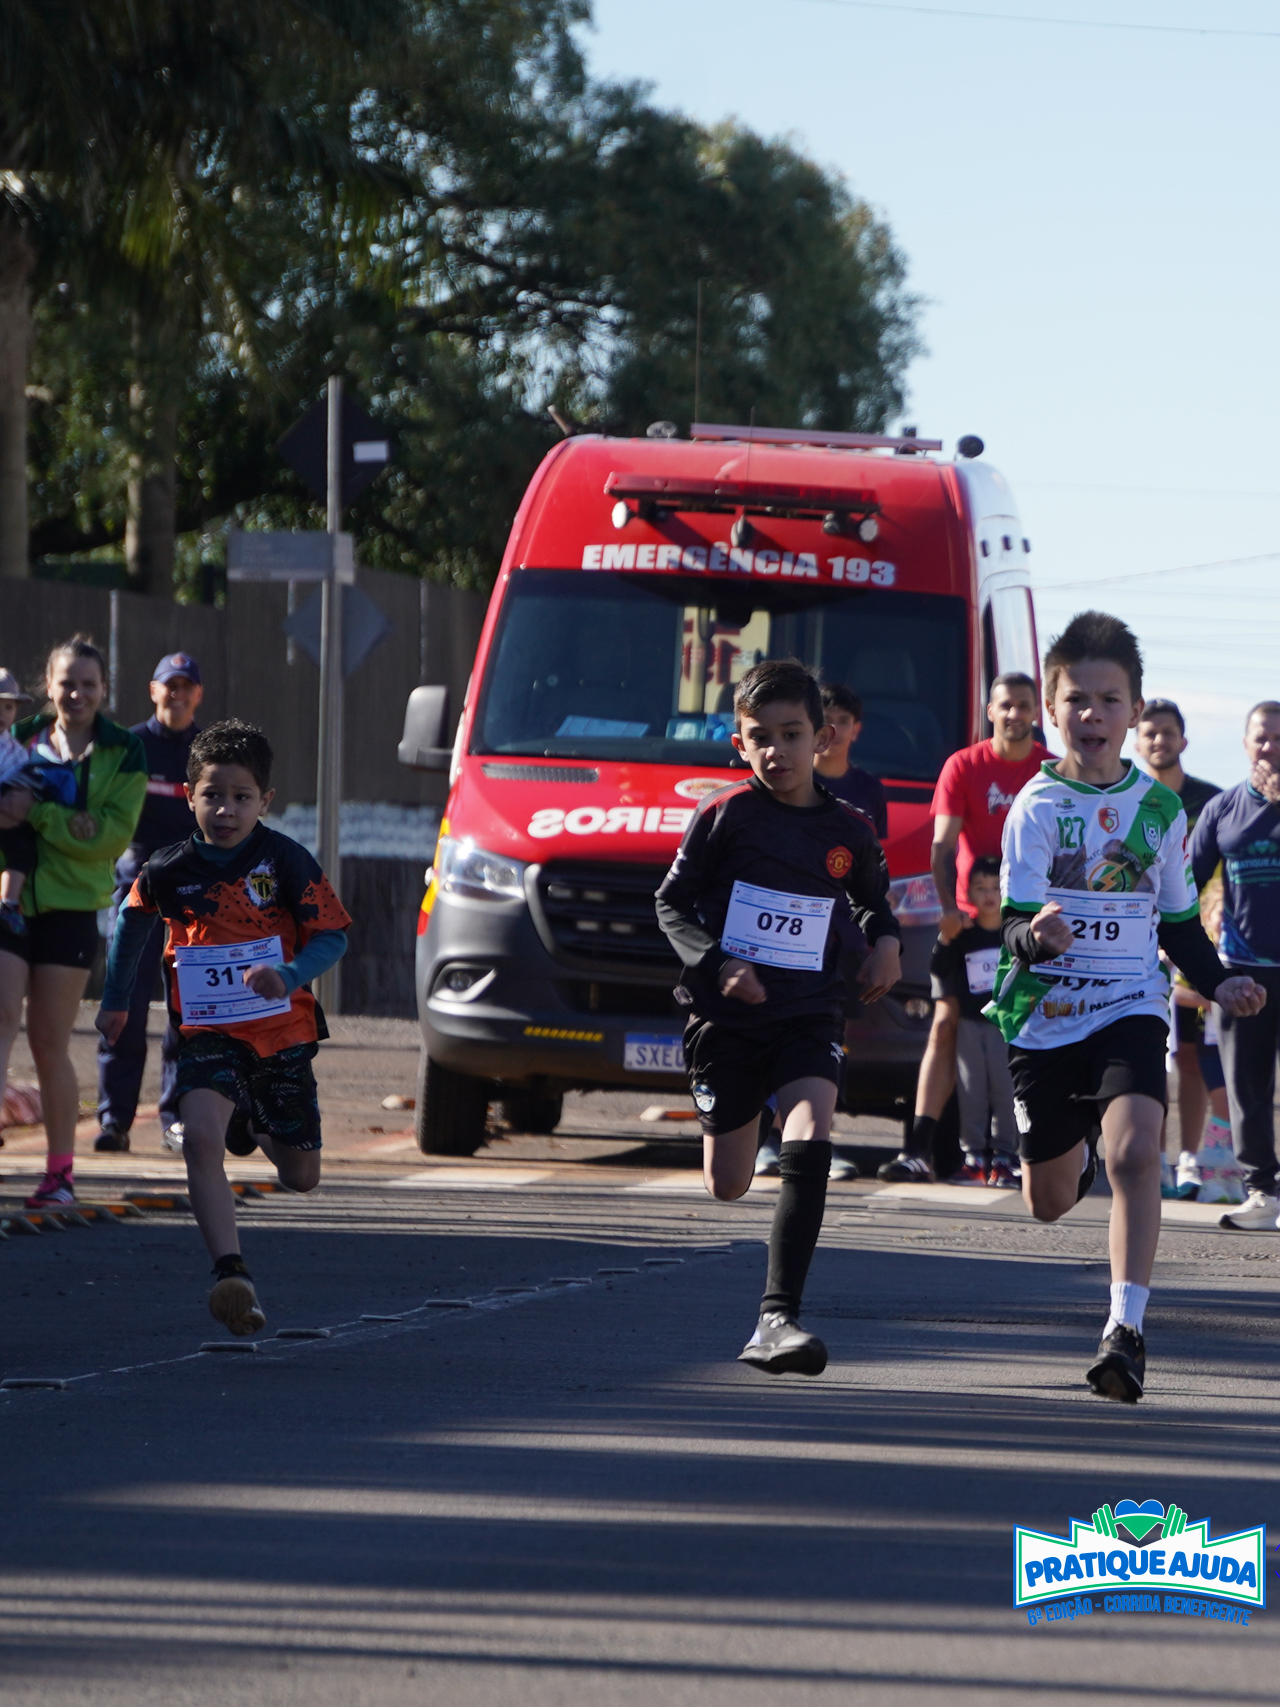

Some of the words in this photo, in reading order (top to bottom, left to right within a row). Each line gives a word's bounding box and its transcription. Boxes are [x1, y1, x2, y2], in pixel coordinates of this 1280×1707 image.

[581, 542, 819, 578] EMERGÊNCIA
[827, 556, 896, 586] 193
[1056, 816, 1086, 848] 127
[757, 911, 803, 936] 078
[1071, 919, 1120, 941] 219
